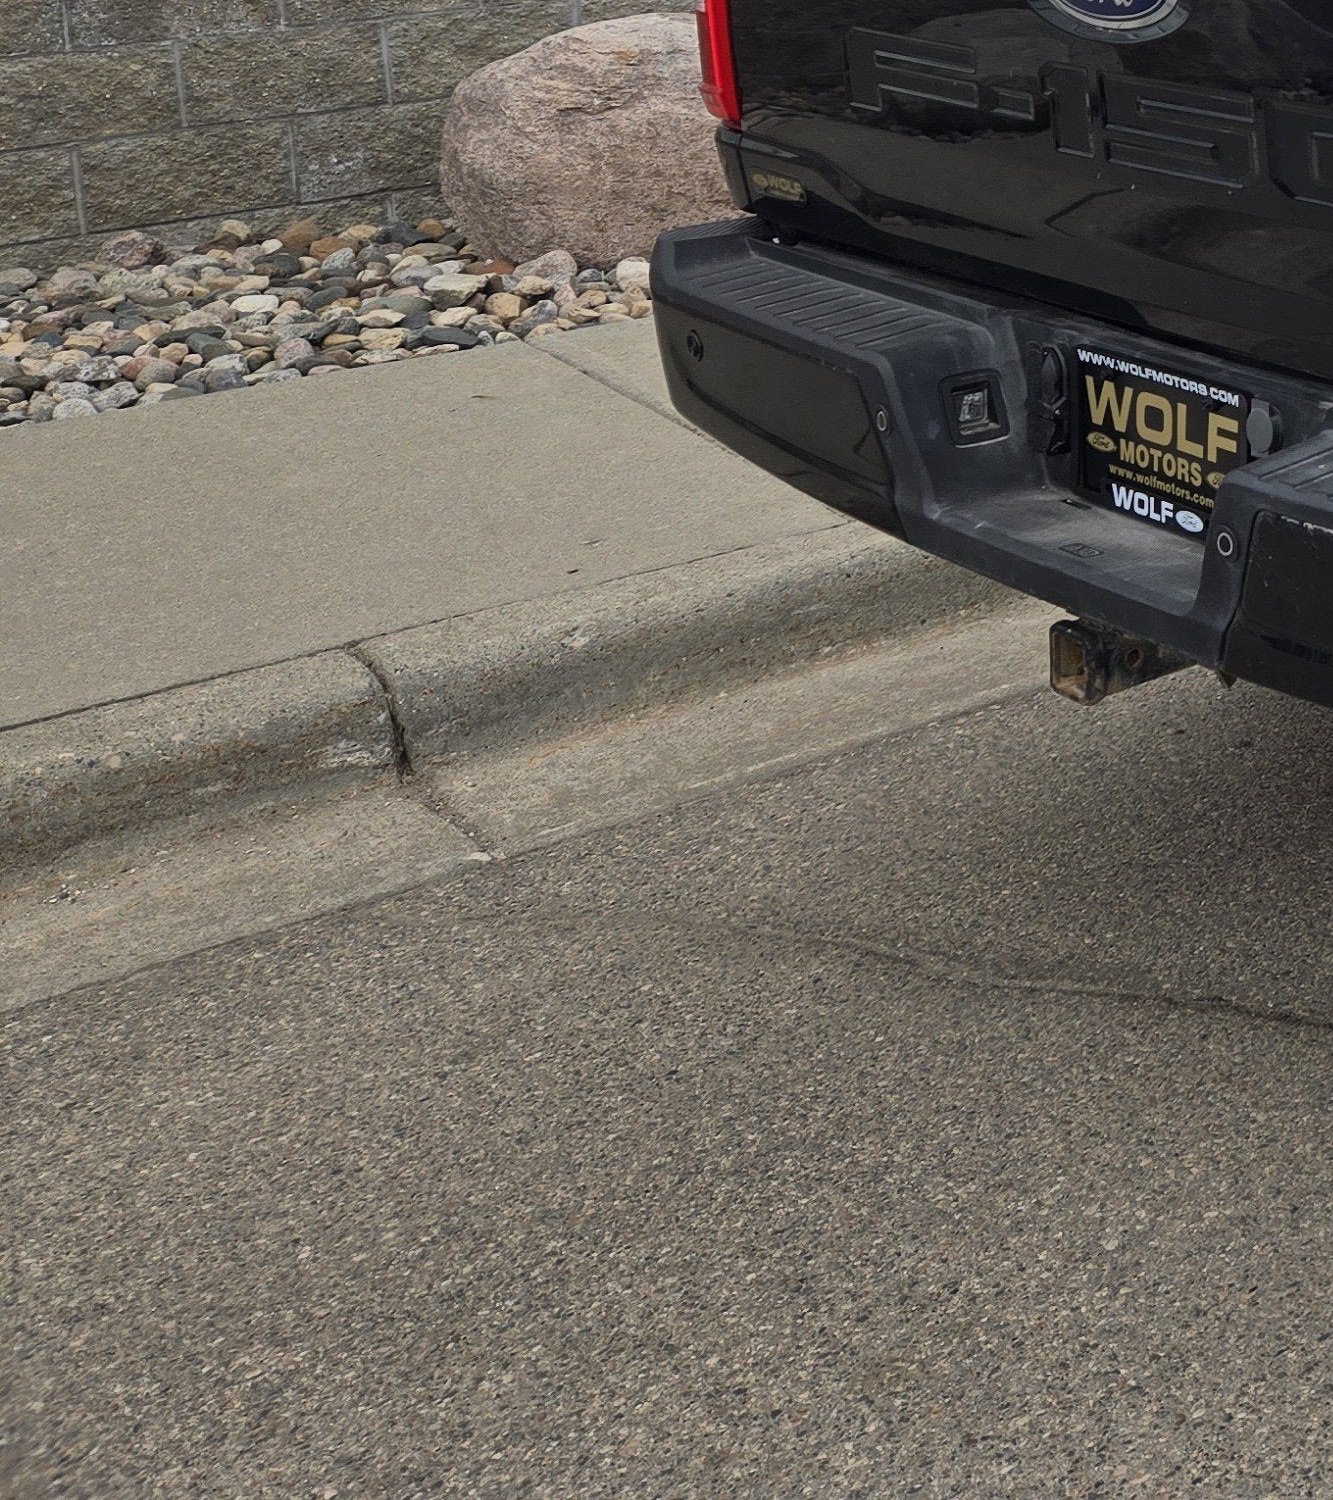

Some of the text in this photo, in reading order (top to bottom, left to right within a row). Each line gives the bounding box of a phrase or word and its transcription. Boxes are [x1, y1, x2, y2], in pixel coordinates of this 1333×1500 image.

[1085, 374, 1240, 464] WOLF
[1119, 438, 1203, 487] MOTORS
[1108, 464, 1215, 508] www.wolfmotors.com
[1111, 483, 1174, 524] WOLF
